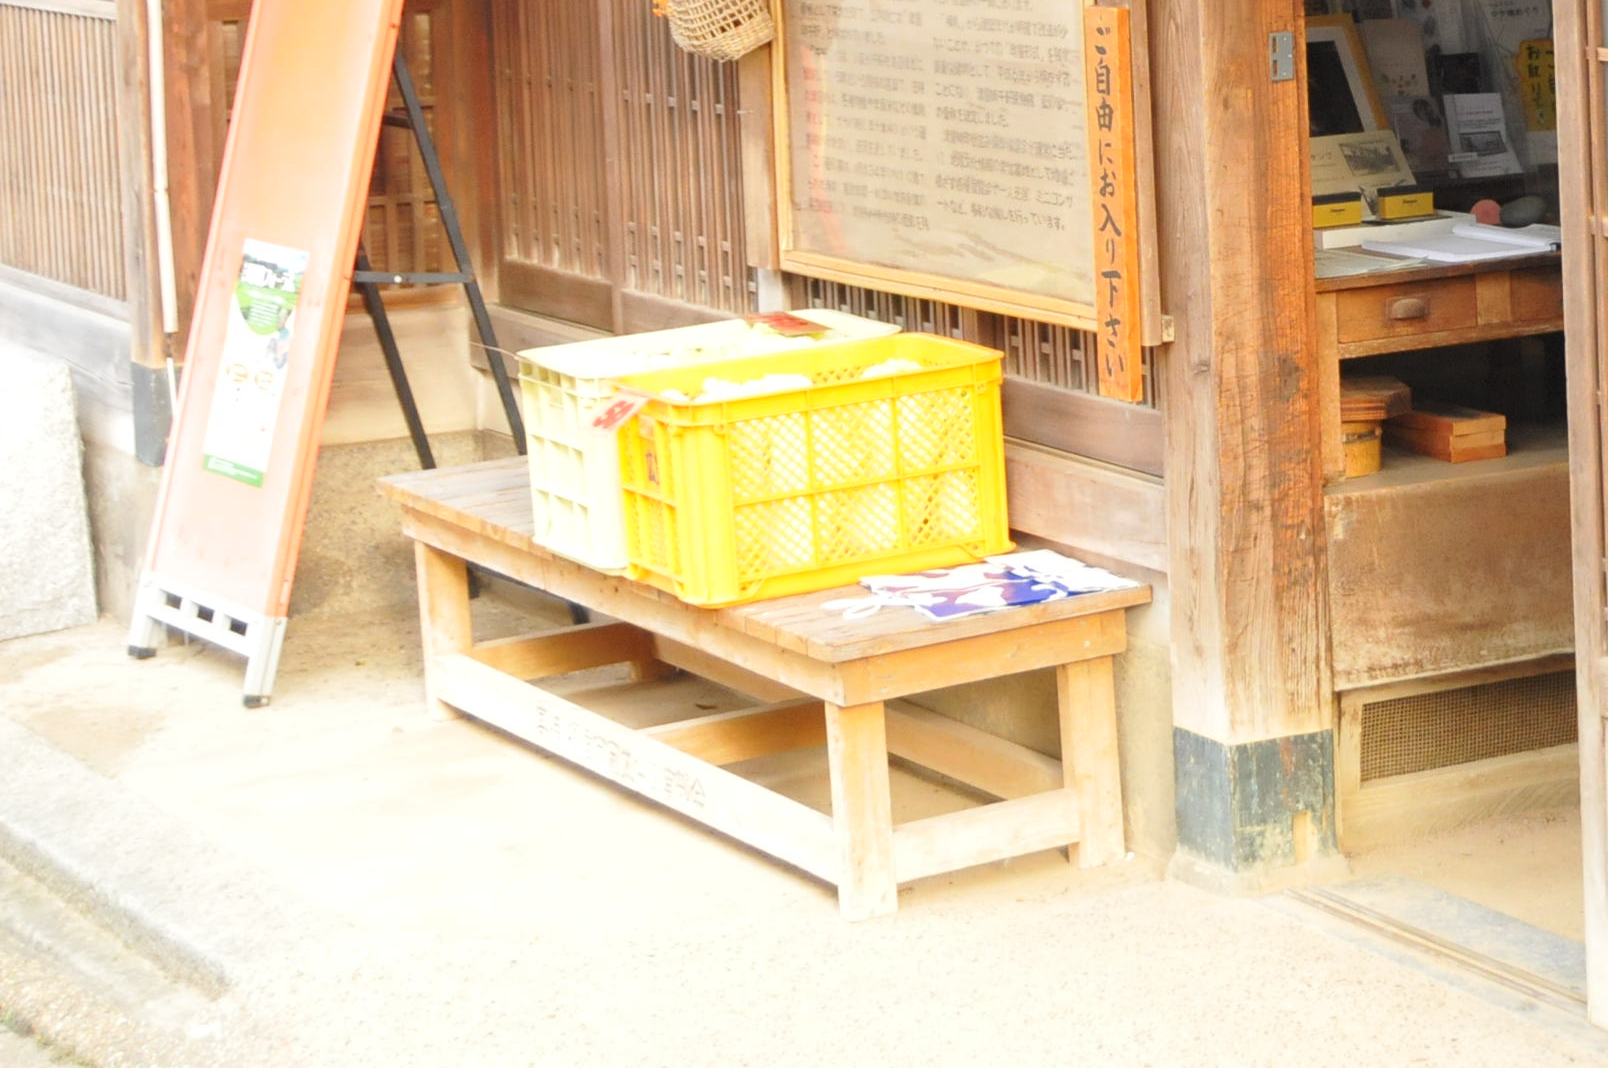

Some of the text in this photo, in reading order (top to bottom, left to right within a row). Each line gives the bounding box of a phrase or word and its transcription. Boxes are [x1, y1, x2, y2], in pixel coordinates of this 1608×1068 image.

[1094, 24, 1130, 380] ご自由にお入り下さい
